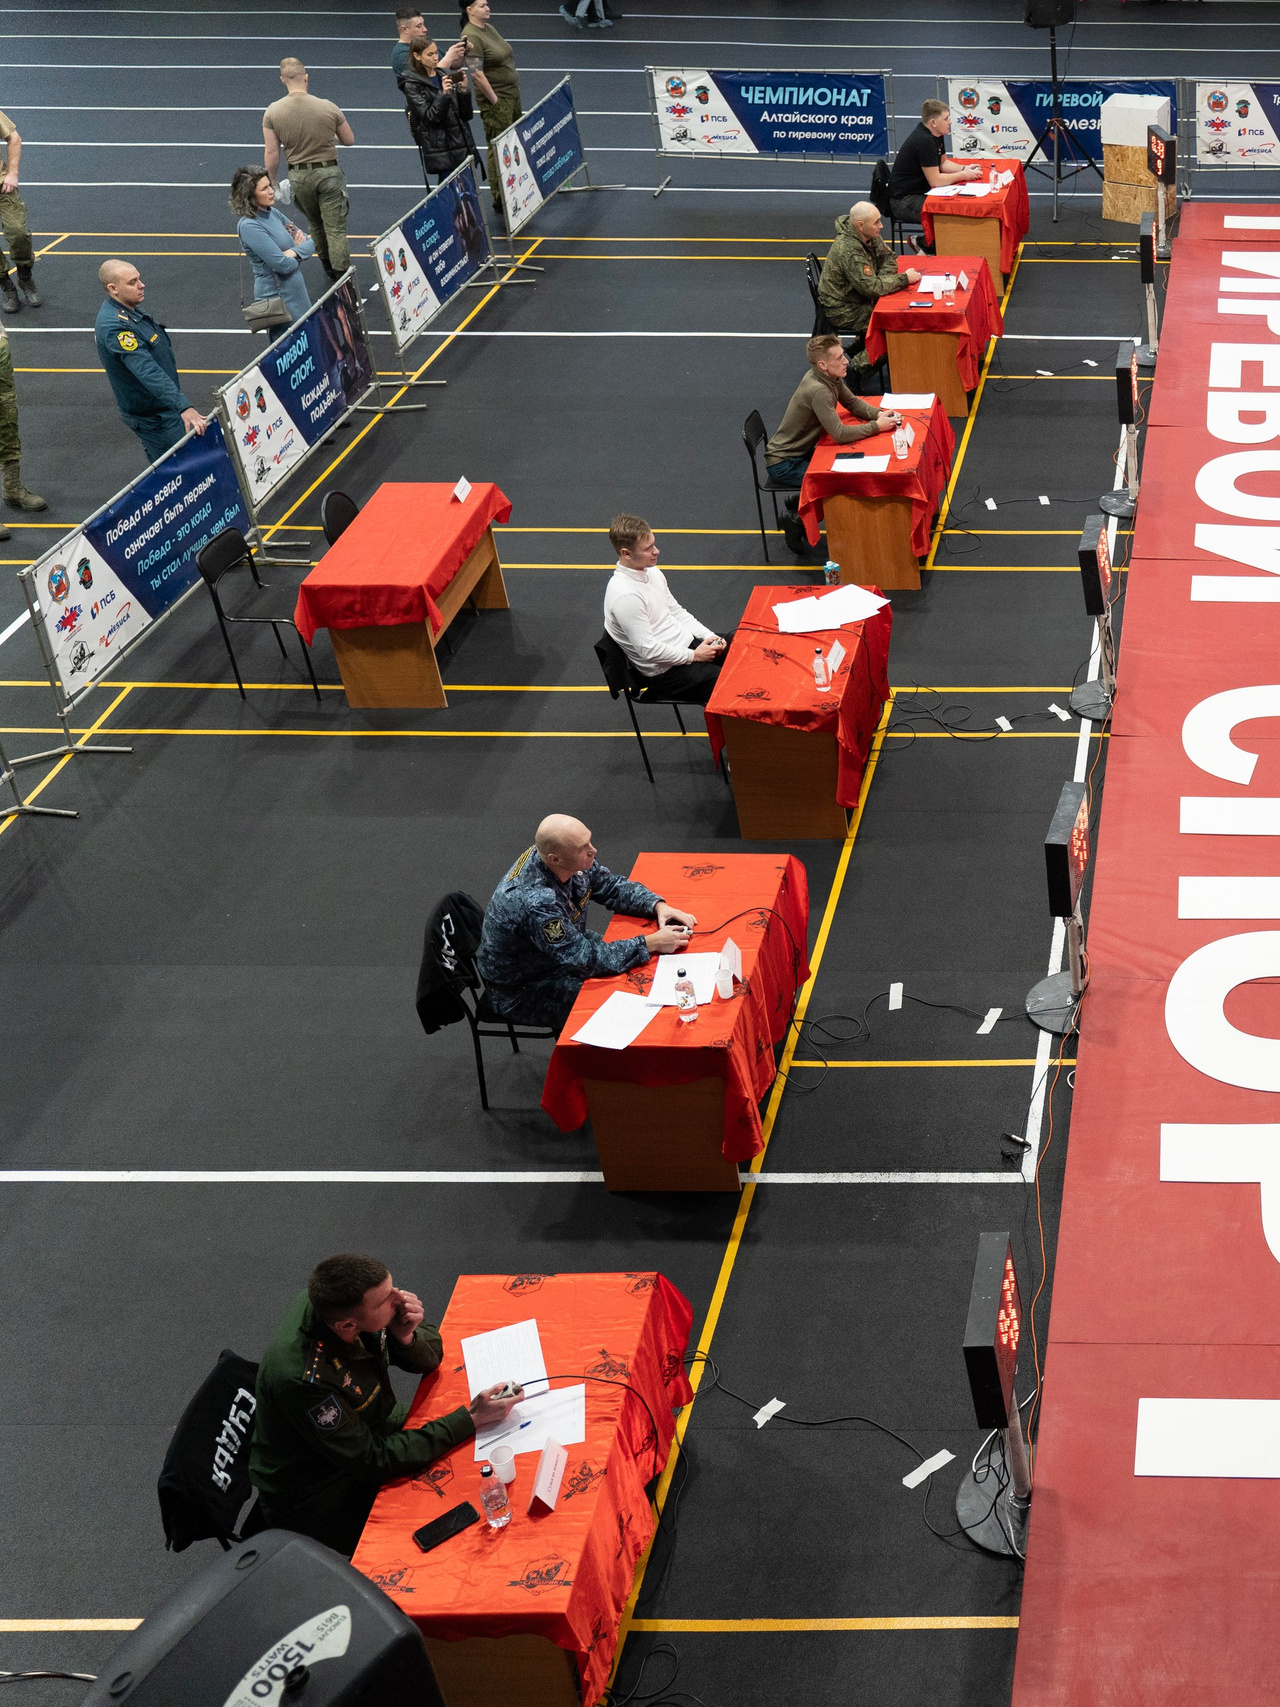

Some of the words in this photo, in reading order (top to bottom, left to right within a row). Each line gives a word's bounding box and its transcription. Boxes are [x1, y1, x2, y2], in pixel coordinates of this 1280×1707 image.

[740, 86, 871, 107] ЧЕМПИОНАТ
[711, 115, 727, 123] ПСБ
[760, 110, 838, 125] Алтайского
[841, 114, 873, 126] края
[773, 130, 786, 139] по
[788, 131, 837, 142] гиревому
[838, 132, 874, 143] спорту
[1002, 125, 1018, 133] ПСБ
[276, 330, 309, 377] ГИРЕВОЙ
[290, 357, 316, 391] СПОРТ.
[300, 371, 330, 411] Каждый
[106, 511, 141, 547] Победа
[141, 499, 153, 515] не
[154, 474, 183, 505] всегда
[124, 519, 164, 560] означает
[163, 502, 184, 524] быть
[183, 473, 217, 508] первым.
[137, 542, 172, 576] Победа
[177, 525, 191, 541] это
[190, 501, 212, 529] когда
[150, 575, 161, 592] ты
[161, 559, 182, 582] стал
[210, 517, 226, 537] чем
[225, 504, 240, 525] был
[100, 589, 116, 610] ПСБ
[211, 1386, 257, 1494] СУДЬЯ
[249, 1642, 290, 1677] WATTS
[250, 1638, 315, 1699] 1500
